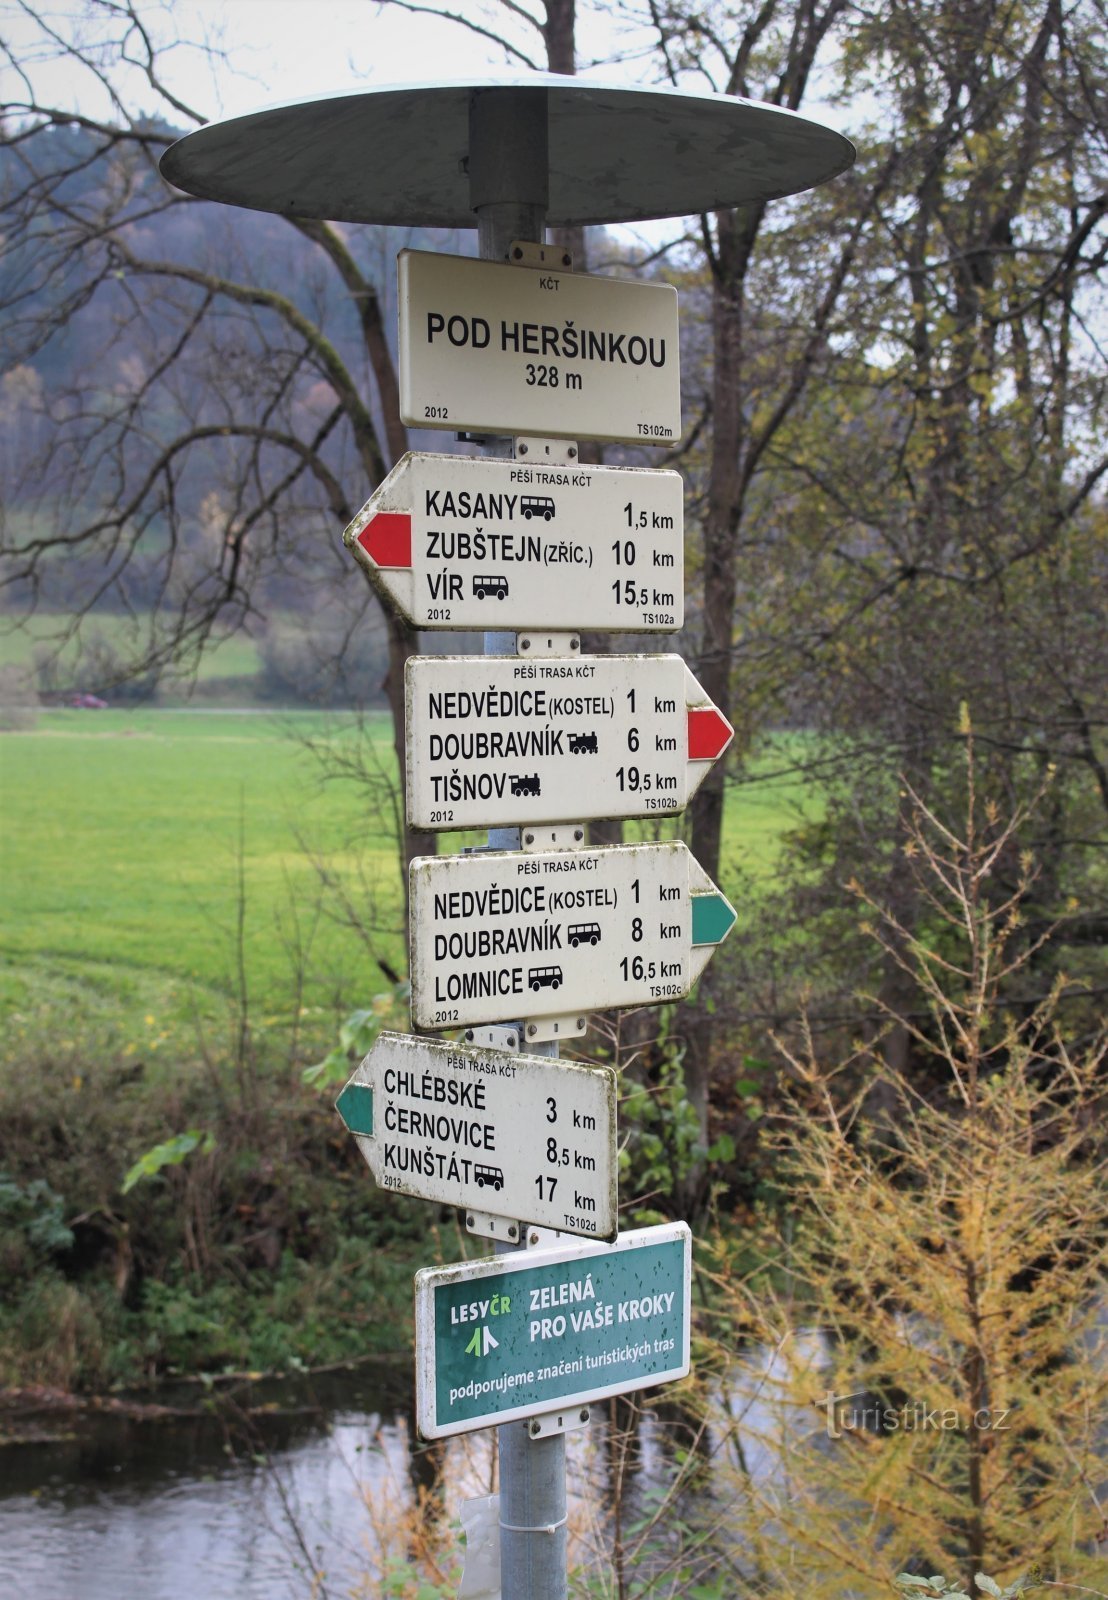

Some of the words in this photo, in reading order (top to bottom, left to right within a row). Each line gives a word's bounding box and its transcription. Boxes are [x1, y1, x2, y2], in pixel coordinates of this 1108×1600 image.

[539, 276, 559, 291] KČT
[427, 312, 491, 348] POD
[501, 320, 666, 368] HERŠINKOU
[525, 364, 559, 387] 328
[565, 372, 583, 389] m
[424, 406, 448, 419] 2012
[637, 424, 673, 437] TS102m
[510, 470, 533, 484] PĚŠÍ
[536, 472, 570, 486] TRASA
[572, 474, 591, 487] KČT
[425, 490, 517, 520] KASANY
[623, 502, 647, 530] 1,5
[653, 515, 674, 530] km
[426, 527, 541, 562] ZUBŠTEJN
[543, 544, 593, 568] (ZŘÍC.)
[611, 540, 636, 566] 10
[653, 552, 674, 567] km
[426, 567, 464, 600] VÍR
[611, 579, 648, 608] 15,5
[653, 591, 674, 606] km
[427, 609, 451, 620] 2012
[642, 612, 675, 625] TS102a
[514, 666, 537, 679] PĚŠÍ
[539, 667, 574, 678] TRASA
[576, 665, 595, 678] KČT
[429, 685, 546, 720] NEDVĚDICE
[549, 696, 615, 720] (KOSTEL)
[627, 688, 636, 713] 1
[654, 697, 676, 713] km
[430, 724, 564, 761] DOUBRAVNÍK
[627, 727, 639, 753] 6
[656, 735, 677, 751] km
[430, 769, 506, 802] TIŠNOV
[616, 766, 651, 793] 19,5
[656, 773, 677, 790] km
[430, 810, 453, 822] 2012
[645, 798, 677, 810] TS102b
[517, 861, 540, 875] PĚŠÍ
[543, 861, 577, 874] TRASA
[578, 857, 599, 871] KČT
[434, 883, 545, 920] NEDVĚDICE
[548, 887, 618, 915] (KOSTEL)
[630, 879, 640, 904] 1
[659, 885, 681, 901] km
[435, 918, 562, 962] DOUBRAVNÍK
[631, 917, 643, 943] 8
[660, 923, 681, 939] km
[435, 967, 523, 1002] LOMNICE
[619, 955, 656, 983] 16,5
[661, 961, 682, 978] km
[650, 985, 682, 998] TS102c
[435, 1010, 459, 1023] 2012
[447, 1056, 466, 1071] PĚŠÍ
[468, 1060, 497, 1075] TRASA
[499, 1064, 516, 1078] KČT
[384, 1068, 486, 1110] CHLÉBSKÉ
[546, 1097, 557, 1123] 3
[573, 1110, 596, 1130] km
[384, 1100, 496, 1151] ČERNOVICE
[546, 1137, 570, 1167] 8,5
[574, 1151, 596, 1171] km
[384, 1143, 472, 1184] KUNŠTÁT
[535, 1175, 558, 1202] 17
[574, 1191, 596, 1212] km
[384, 1175, 402, 1189] 2012
[564, 1215, 596, 1231] TS102d
[529, 1273, 595, 1311] ZELENÁ
[530, 1315, 567, 1342] PRO
[570, 1301, 614, 1332] VAŠE
[618, 1292, 675, 1323] KROKY
[449, 1370, 534, 1405] podporujeme
[537, 1356, 583, 1380] značení
[585, 1343, 651, 1370] turistických
[654, 1337, 675, 1352] tras
